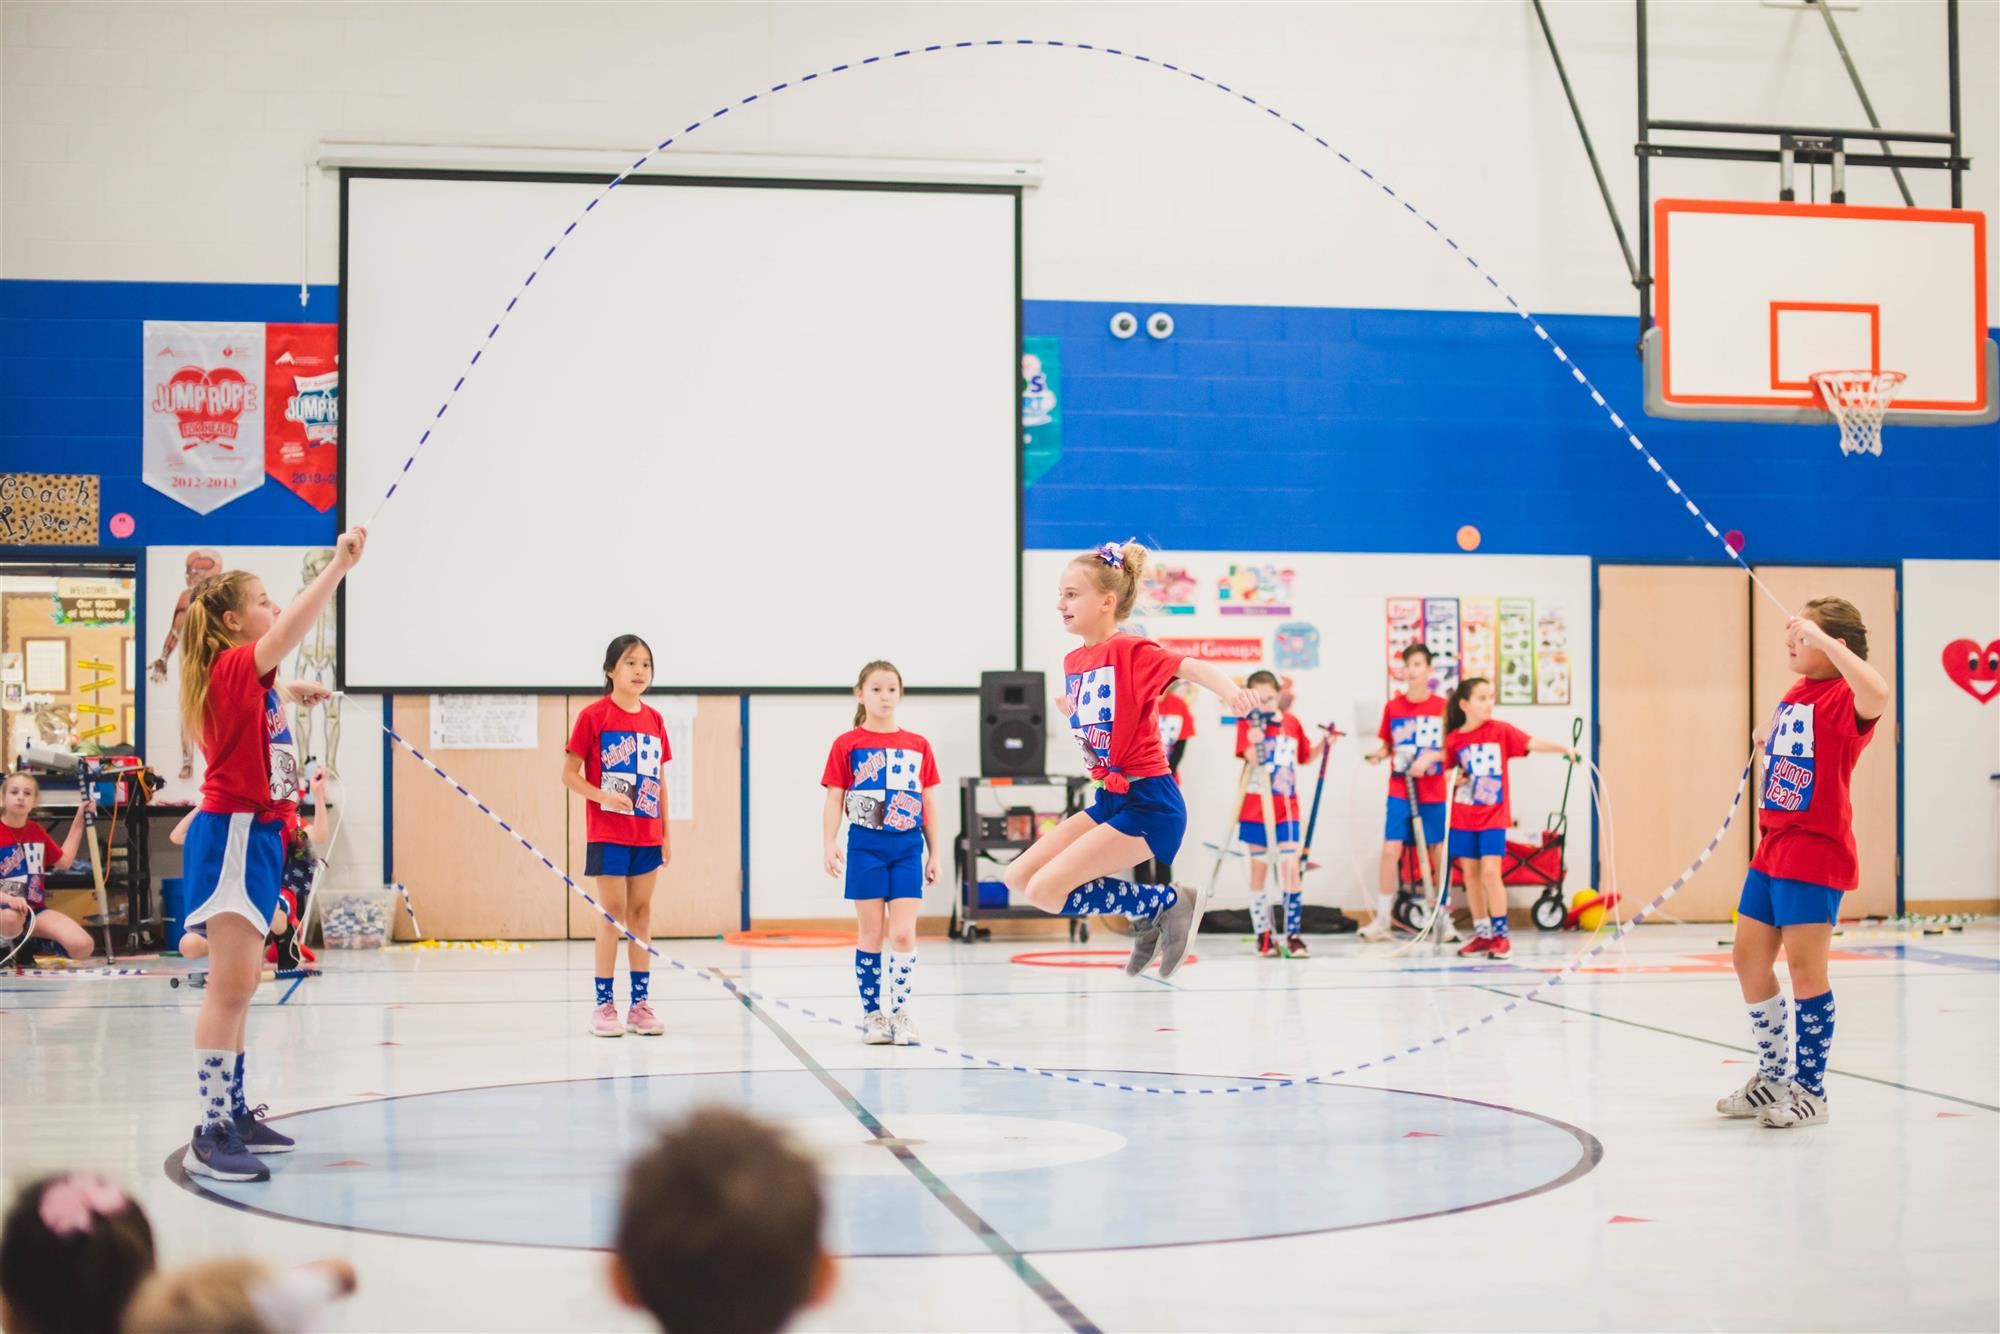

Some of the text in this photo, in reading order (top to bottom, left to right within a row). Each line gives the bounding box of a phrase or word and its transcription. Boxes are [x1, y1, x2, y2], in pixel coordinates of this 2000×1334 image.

[0, 477, 90, 506] Coach
[171, 477, 237, 488] 2012-2013
[293, 473, 337, 484] 2013-2
[1774, 756, 1813, 793] Jump
[892, 790, 922, 818] Jump
[1766, 774, 1803, 811] Team
[883, 804, 917, 832] Team
